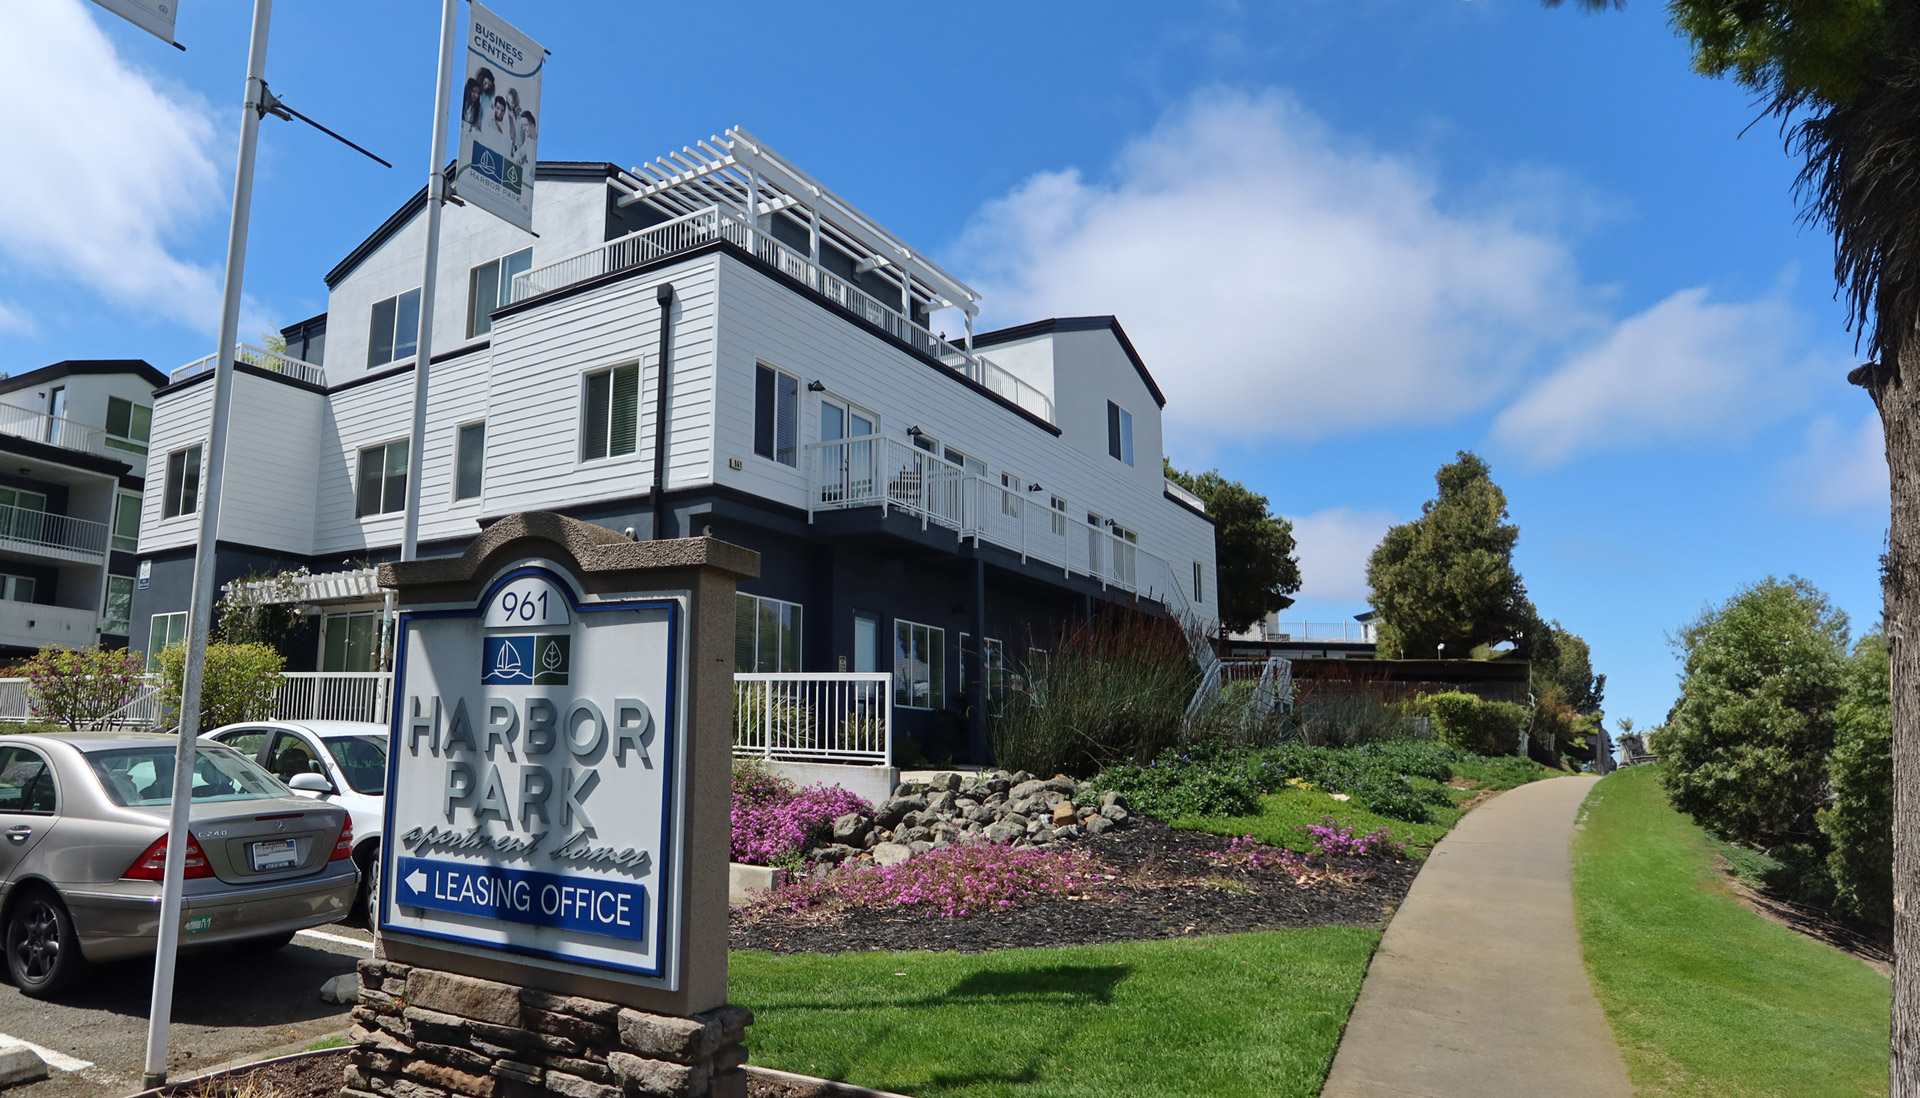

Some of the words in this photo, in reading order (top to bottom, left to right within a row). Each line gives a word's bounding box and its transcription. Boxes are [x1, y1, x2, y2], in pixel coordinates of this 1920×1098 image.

[474, 35, 515, 69] CENTER
[475, 22, 523, 62] BUSINESS
[470, 170, 501, 192] HARBOR
[502, 189, 521, 203] PARK
[501, 590, 549, 622] 961
[407, 695, 652, 760] HARBOR
[443, 761, 601, 829] PARK
[400, 824, 549, 856] apartment
[550, 830, 652, 868] homes
[434, 870, 531, 912] LEASING
[541, 884, 632, 926] OFFICE
